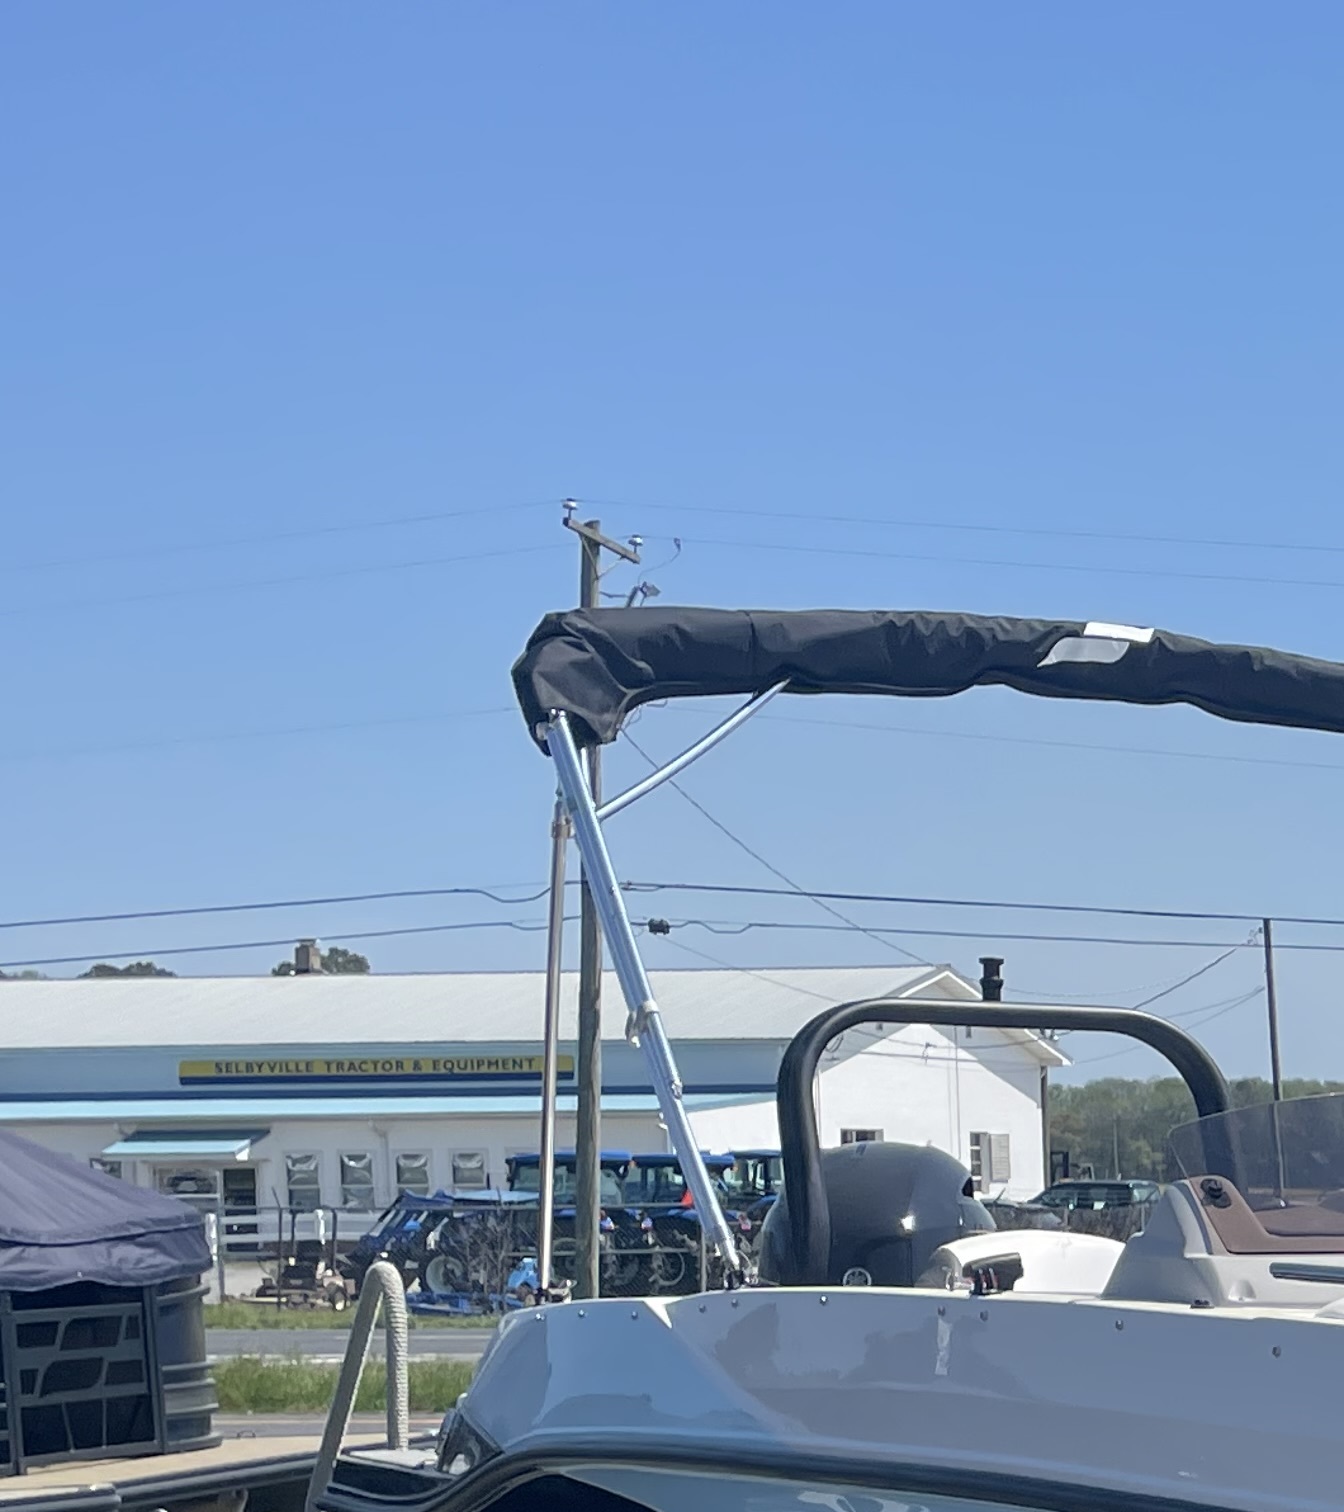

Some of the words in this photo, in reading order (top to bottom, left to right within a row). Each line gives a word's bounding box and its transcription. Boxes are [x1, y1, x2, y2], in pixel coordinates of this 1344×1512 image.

[214, 1060, 314, 1075] SELBYVILLE
[324, 1059, 405, 1074] TRACTOR
[413, 1060, 423, 1073] &
[431, 1057, 536, 1074] EQUIPMENT
